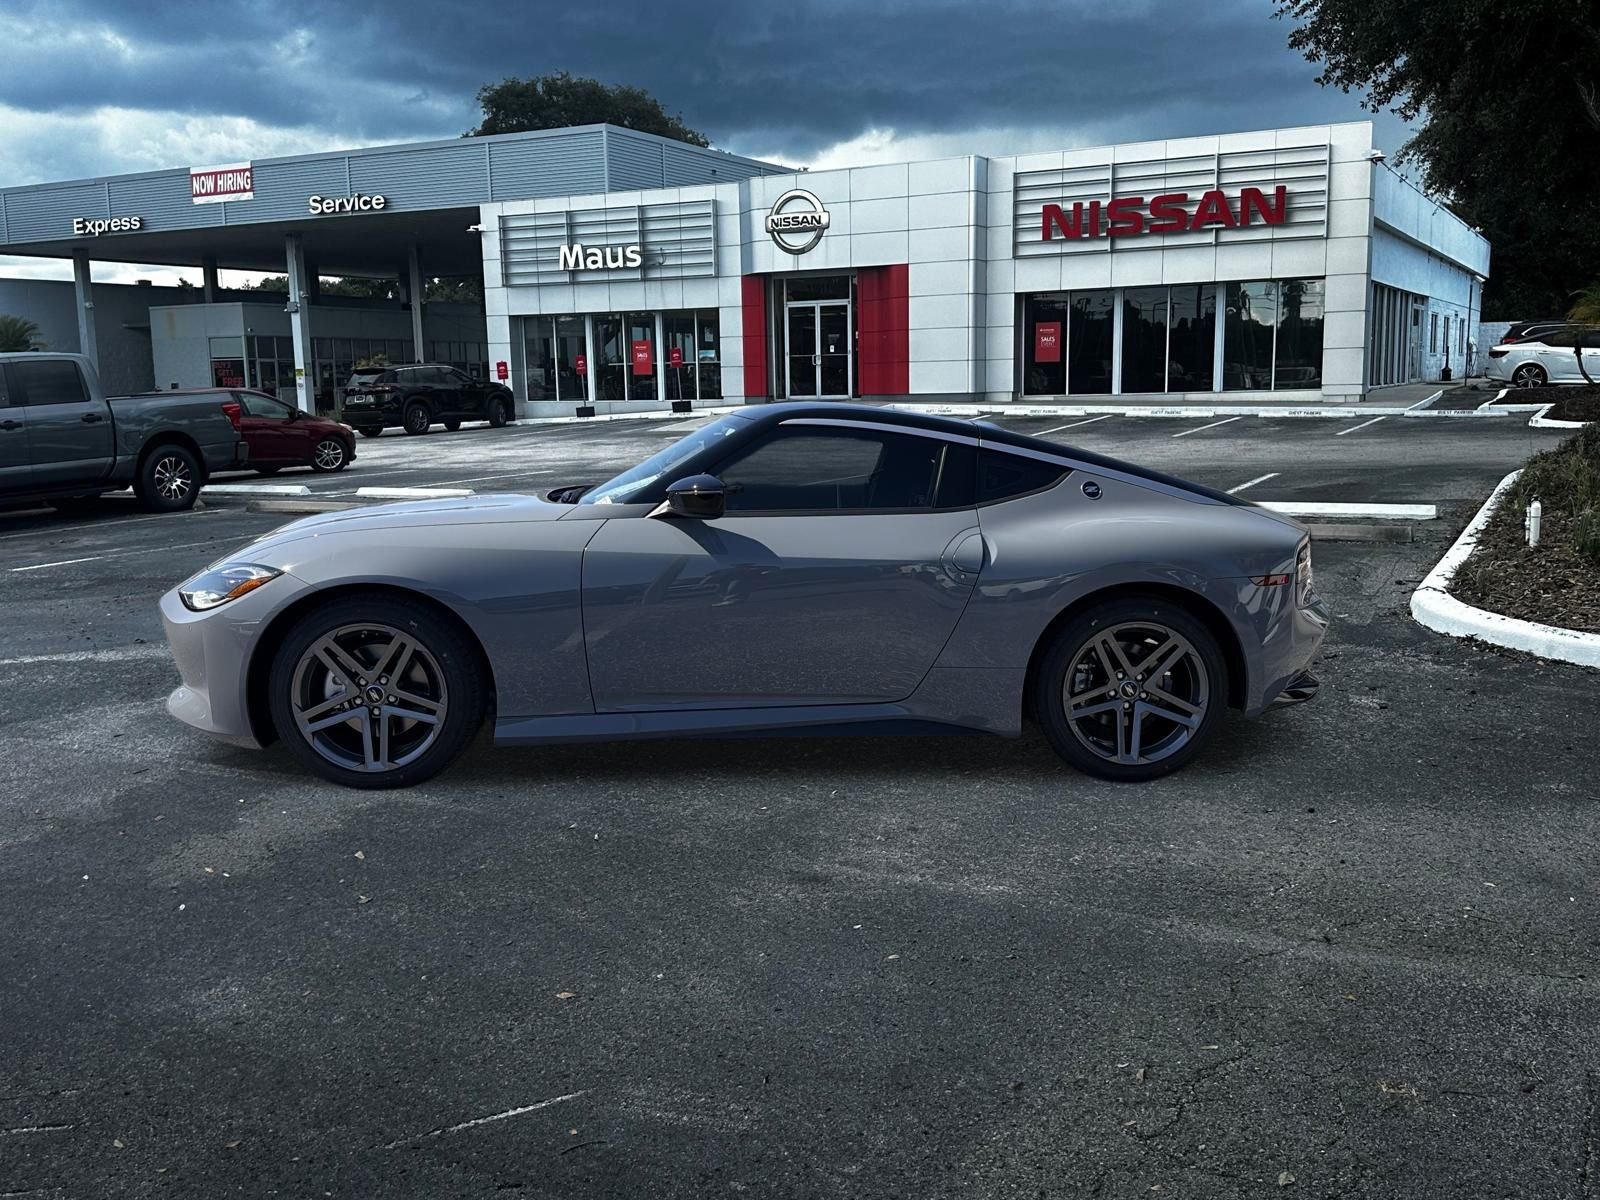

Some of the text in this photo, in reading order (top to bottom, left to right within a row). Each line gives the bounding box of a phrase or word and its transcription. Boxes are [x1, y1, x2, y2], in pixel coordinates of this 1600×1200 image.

[192, 170, 251, 195] NOW HIRING
[308, 193, 385, 215] Service
[1042, 184, 1287, 241] NISSAN
[73, 216, 141, 236] Express
[770, 214, 823, 228] NISSAN
[558, 242, 643, 271] Maus
